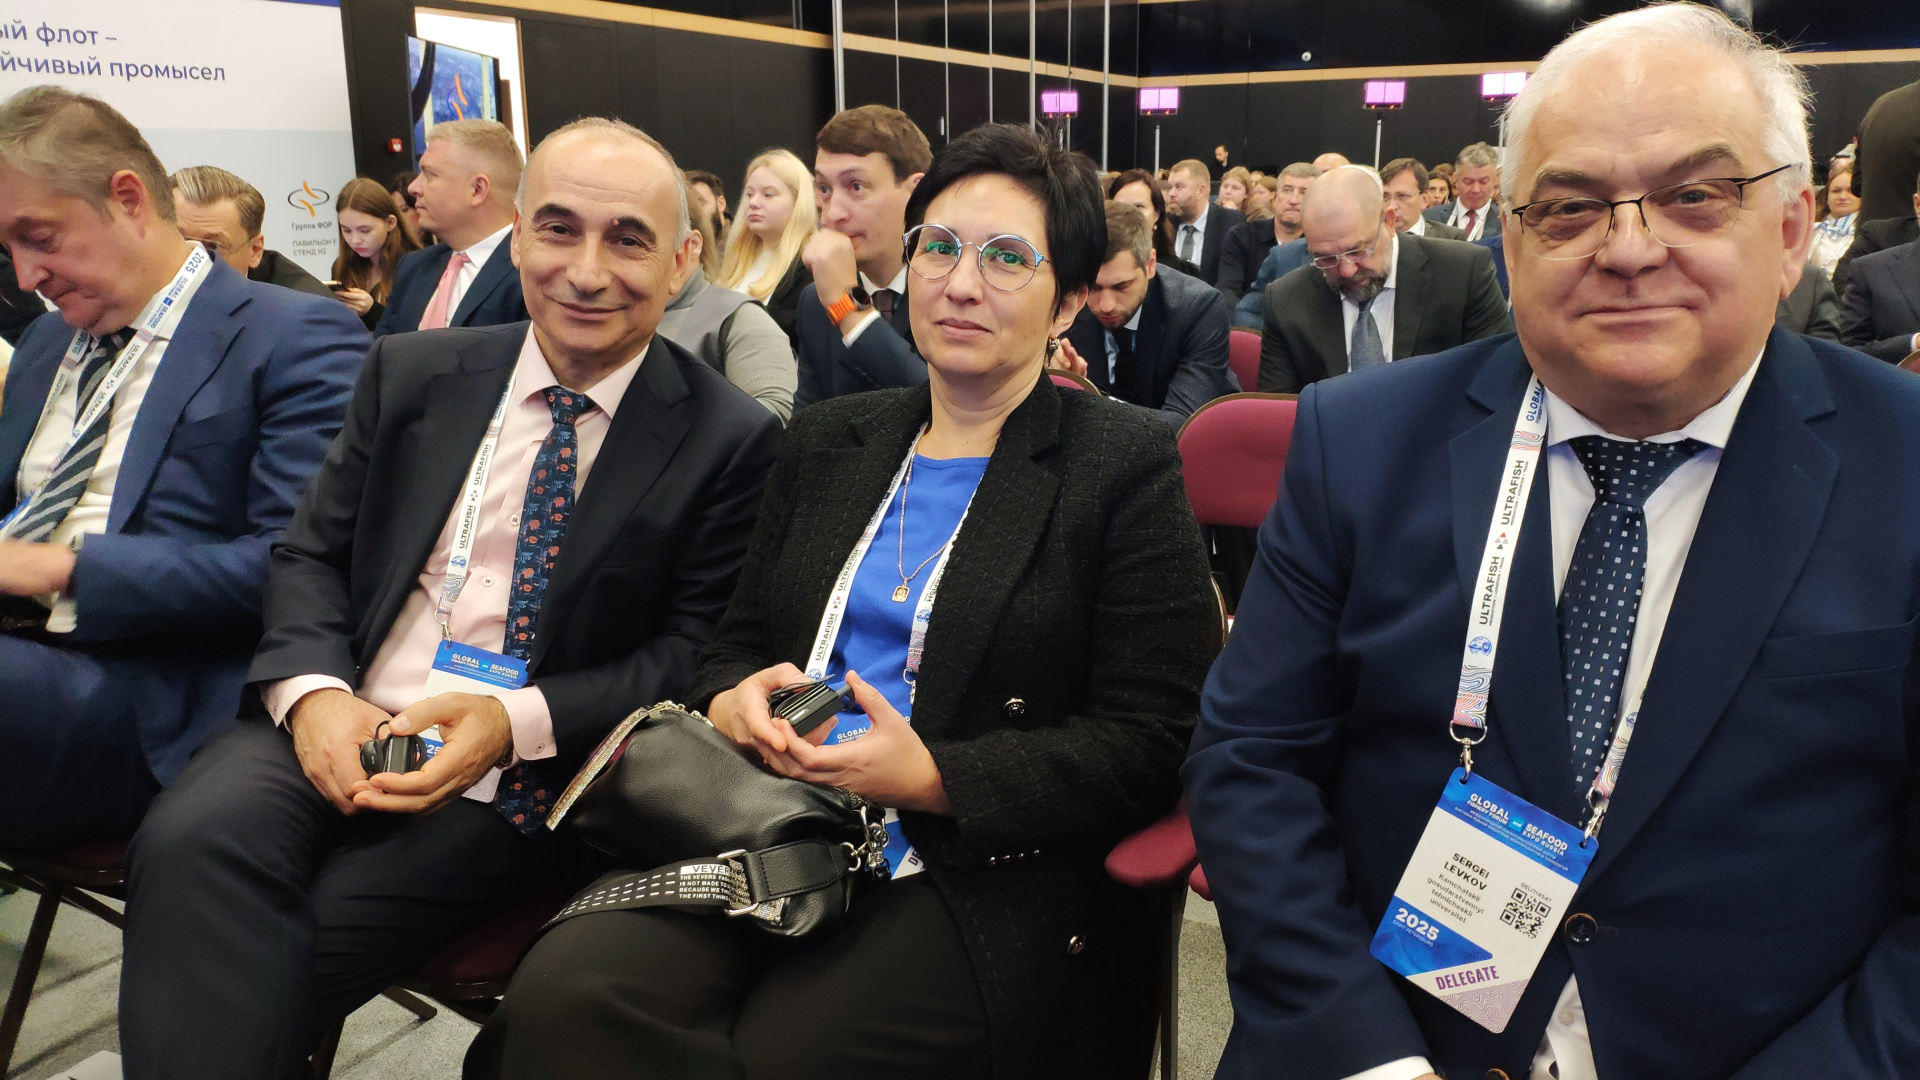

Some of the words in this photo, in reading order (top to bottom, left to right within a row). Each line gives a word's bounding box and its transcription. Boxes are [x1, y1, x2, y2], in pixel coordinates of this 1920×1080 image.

[36, 21, 98, 47] флот
[0, 50, 101, 76] йчивый
[109, 62, 225, 81] промысел
[292, 222, 315, 231] Группа
[317, 221, 332, 229] ФОР
[293, 239, 331, 247] ПАВИЛЬОН
[185, 252, 205, 274] 2025
[171, 277, 188, 298] GLOBAL
[115, 345, 140, 378] ULTRAFISH
[1526, 387, 1541, 421] GLOBAL
[474, 444, 489, 485] ULTRAFISH
[1501, 460, 1524, 525] ULTRAFISH
[459, 505, 473, 549] ULTRAFISH
[838, 549, 859, 591] ULTRAFISH
[1479, 556, 1500, 625] ULTRAFISH
[815, 613, 835, 661] ULTRAFISH
[452, 653, 480, 665] GLOBAL
[490, 664, 519, 676] SEAFOOD
[837, 727, 868, 740] GLOBAL
[1466, 800, 1489, 815] FISHERY
[1488, 812, 1508, 826] FORUM
[1522, 830, 1540, 843] EXPO
[1541, 841, 1564, 856] RUSSIA
[1470, 793, 1509, 820] GLOBAL
[1525, 823, 1568, 851] SEAFOOD
[1443, 861, 1487, 891] LEVKOV
[1452, 853, 1490, 879] SERGEI
[1427, 877, 1485, 915] gosudarstvennyi
[1431, 888, 1473, 917] tehnicheskii
[1438, 873, 1481, 902] Kamchatskii
[1395, 908, 1440, 941] 2025
[1430, 898, 1467, 923] universitet
[1392, 919, 1406, 930] SAINT
[1405, 928, 1434, 947] PETERSBURG
[1435, 965, 1499, 990] DELEGATE
